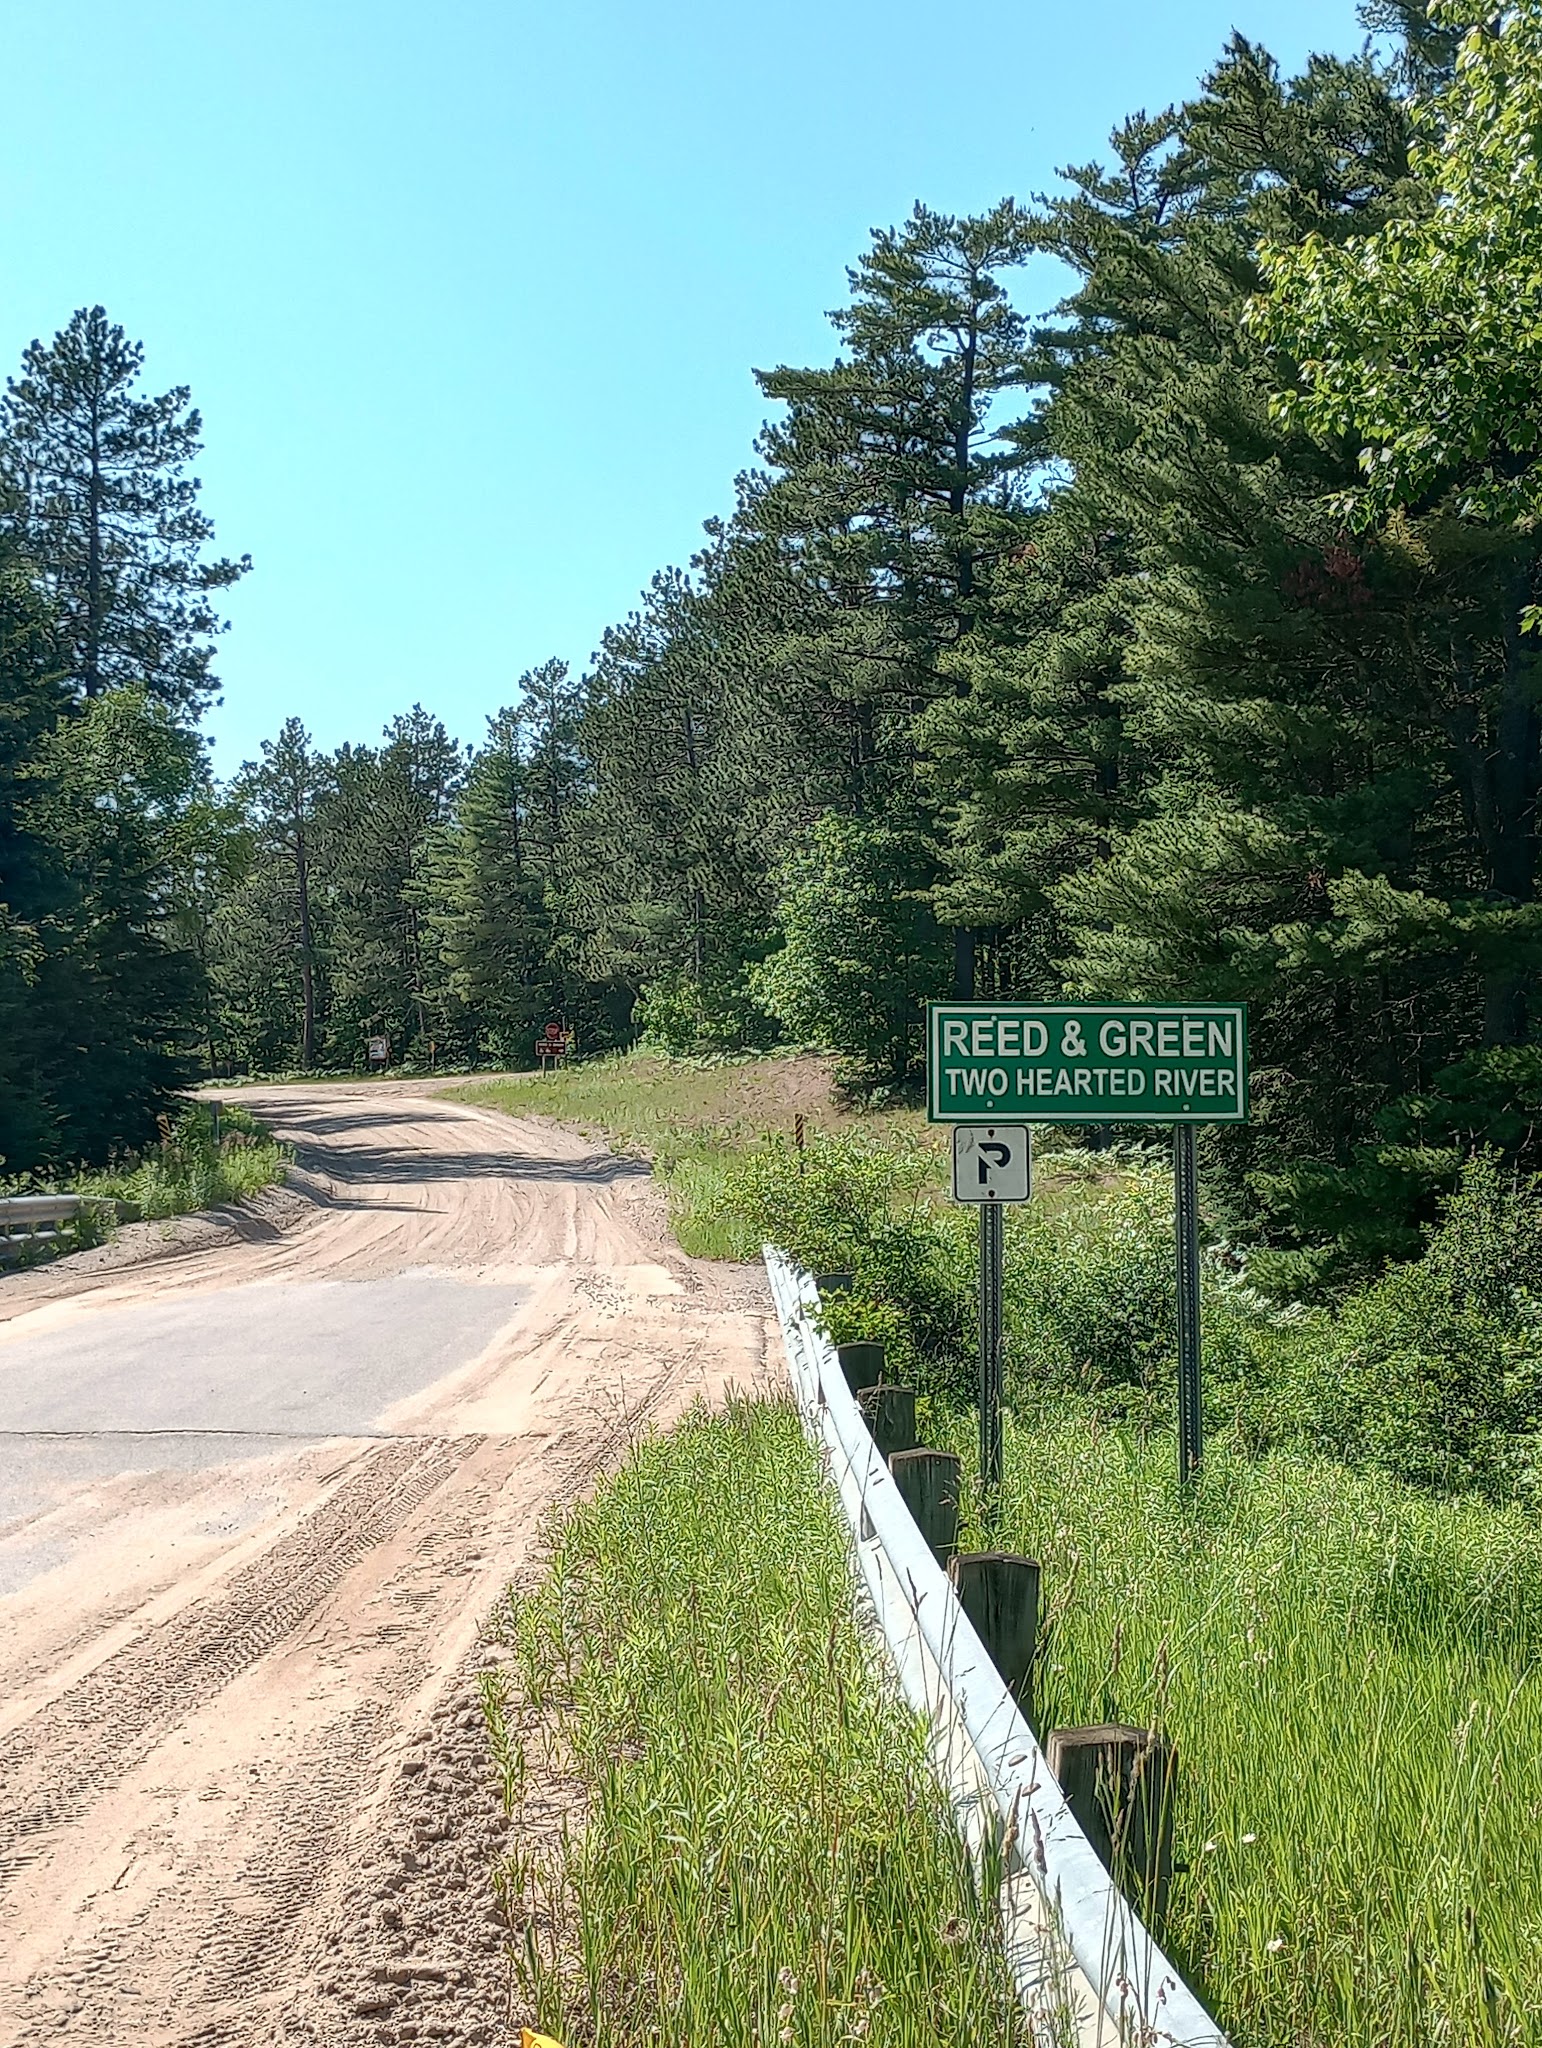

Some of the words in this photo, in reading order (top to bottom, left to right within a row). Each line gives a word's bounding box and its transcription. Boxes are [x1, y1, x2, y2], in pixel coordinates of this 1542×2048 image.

[943, 1020, 1049, 1057] REED
[1061, 1020, 1087, 1057] &
[1099, 1020, 1232, 1057] GREEN
[945, 1068, 1008, 1096] TWO
[1016, 1068, 1145, 1096] HEARTED
[1154, 1068, 1236, 1097] RIVER
